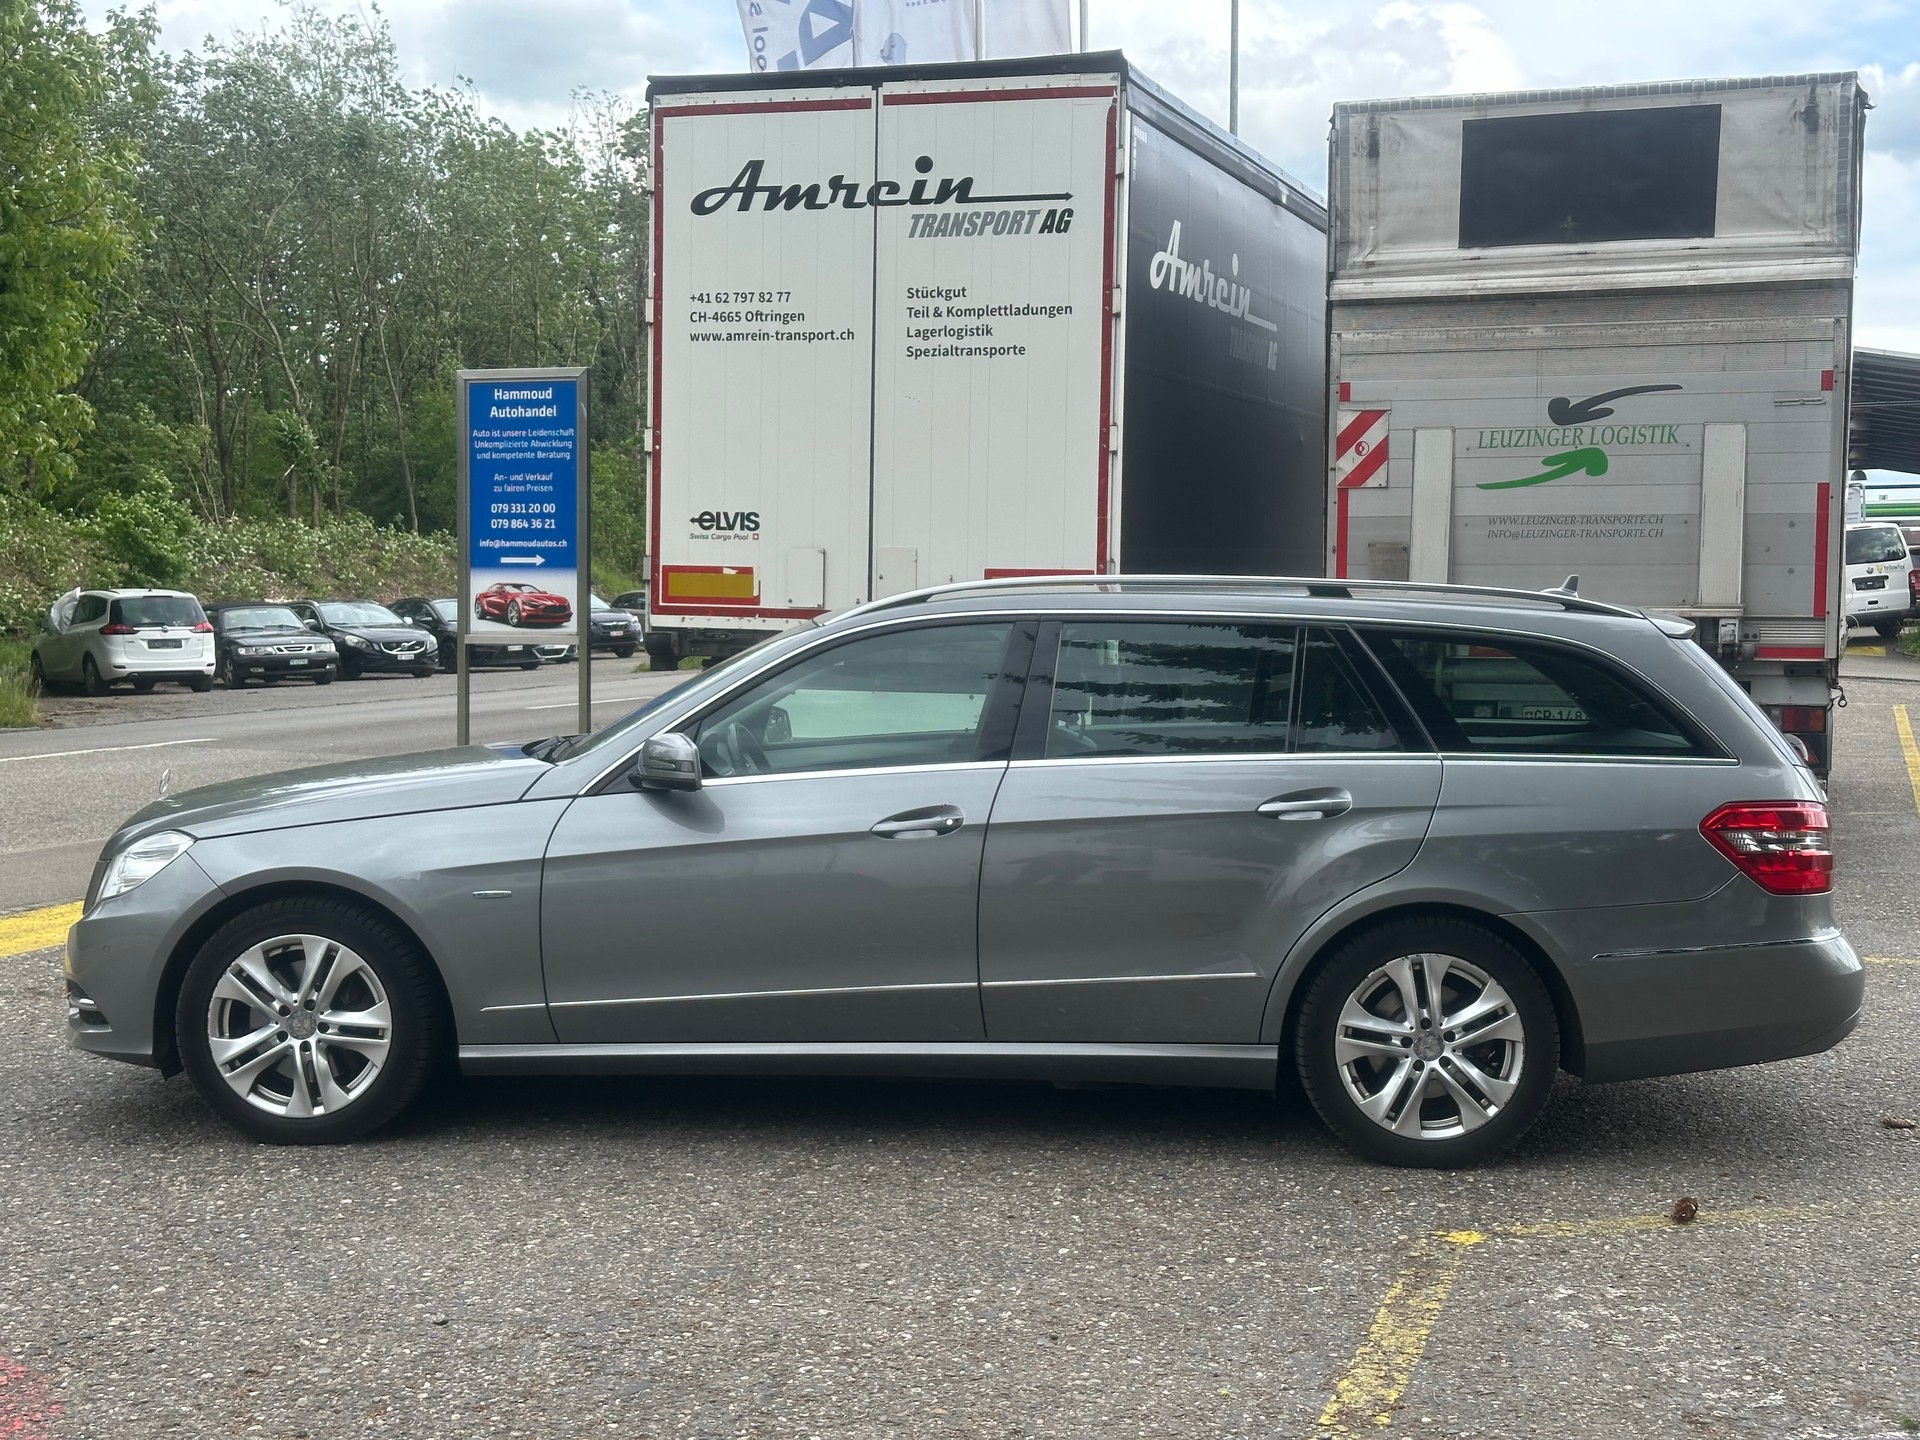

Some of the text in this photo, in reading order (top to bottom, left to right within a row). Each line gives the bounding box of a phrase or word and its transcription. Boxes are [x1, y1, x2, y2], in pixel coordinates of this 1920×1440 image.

[691, 155, 974, 216] Amrein
[908, 207, 1074, 239] TRANSPORT AG
[689, 291, 792, 304] +41 62 797 82 77
[906, 286, 967, 301] Stückgut
[689, 309, 805, 325] CH-4665 Oftringen
[906, 303, 1073, 319] Teil & Komplettladungen
[689, 328, 855, 343] www.amrein-transport.ch
[906, 324, 994, 341] Lagerlogistik
[906, 344, 1026, 360] Spezialtransporte
[494, 387, 553, 400] Hammoud
[490, 405, 557, 418] Autohandel
[472, 429, 490, 438] Auto
[491, 429, 501, 437] ist
[527, 428, 575, 437] Leidenschaft
[1478, 425, 1680, 449] LEUZINGER LOGISTIK
[474, 439, 573, 449] Unkomplizierte Abwicklung
[476, 451, 571, 460] und kompetente Beratung
[493, 472, 554, 481] An- und Verkauf
[504, 484, 525, 492] fairen
[526, 484, 554, 492] Preisen
[491, 503, 556, 513] 079 331 20 00
[491, 518, 556, 529] 079 864 36 21
[1488, 514, 1664, 526] WWW.LEUZINGER-TRANSPORTE.CH
[711, 533, 732, 541] Cargo
[1487, 528, 1664, 540] INFO@LEUZINGER-TRANSPORTE.CH
[479, 539, 568, 548] info@hammoudautos.ch
